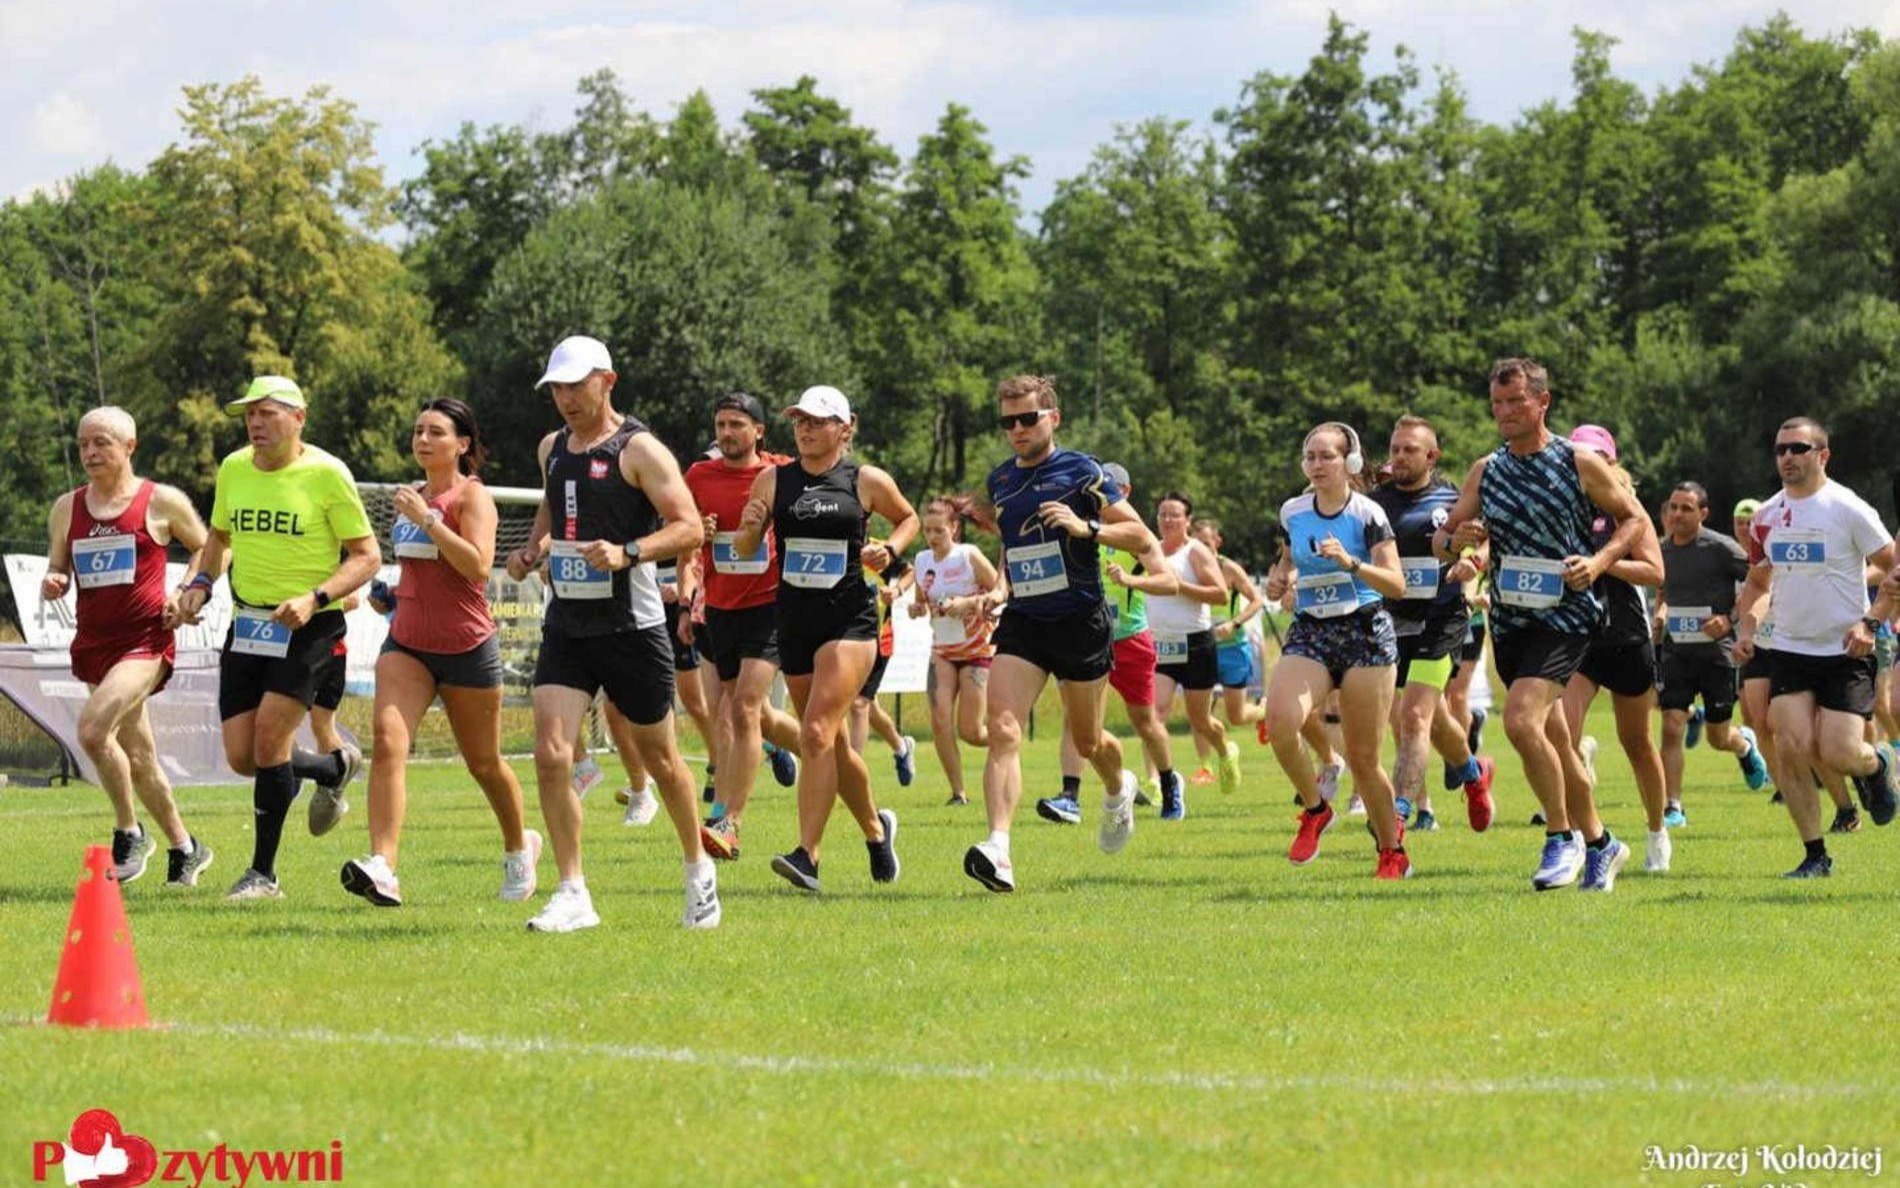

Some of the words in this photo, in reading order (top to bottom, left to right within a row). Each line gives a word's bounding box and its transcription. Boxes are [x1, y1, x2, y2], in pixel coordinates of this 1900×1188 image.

[400, 523, 420, 540] 97
[1785, 543, 1808, 560] 63
[92, 551, 116, 571] 67
[561, 558, 587, 580] 88
[801, 554, 826, 572] 72
[1021, 559, 1045, 580] 94
[1518, 572, 1542, 592] 82
[1315, 585, 1340, 603] 32
[251, 620, 273, 639] 76
[1680, 618, 1698, 631] 83
